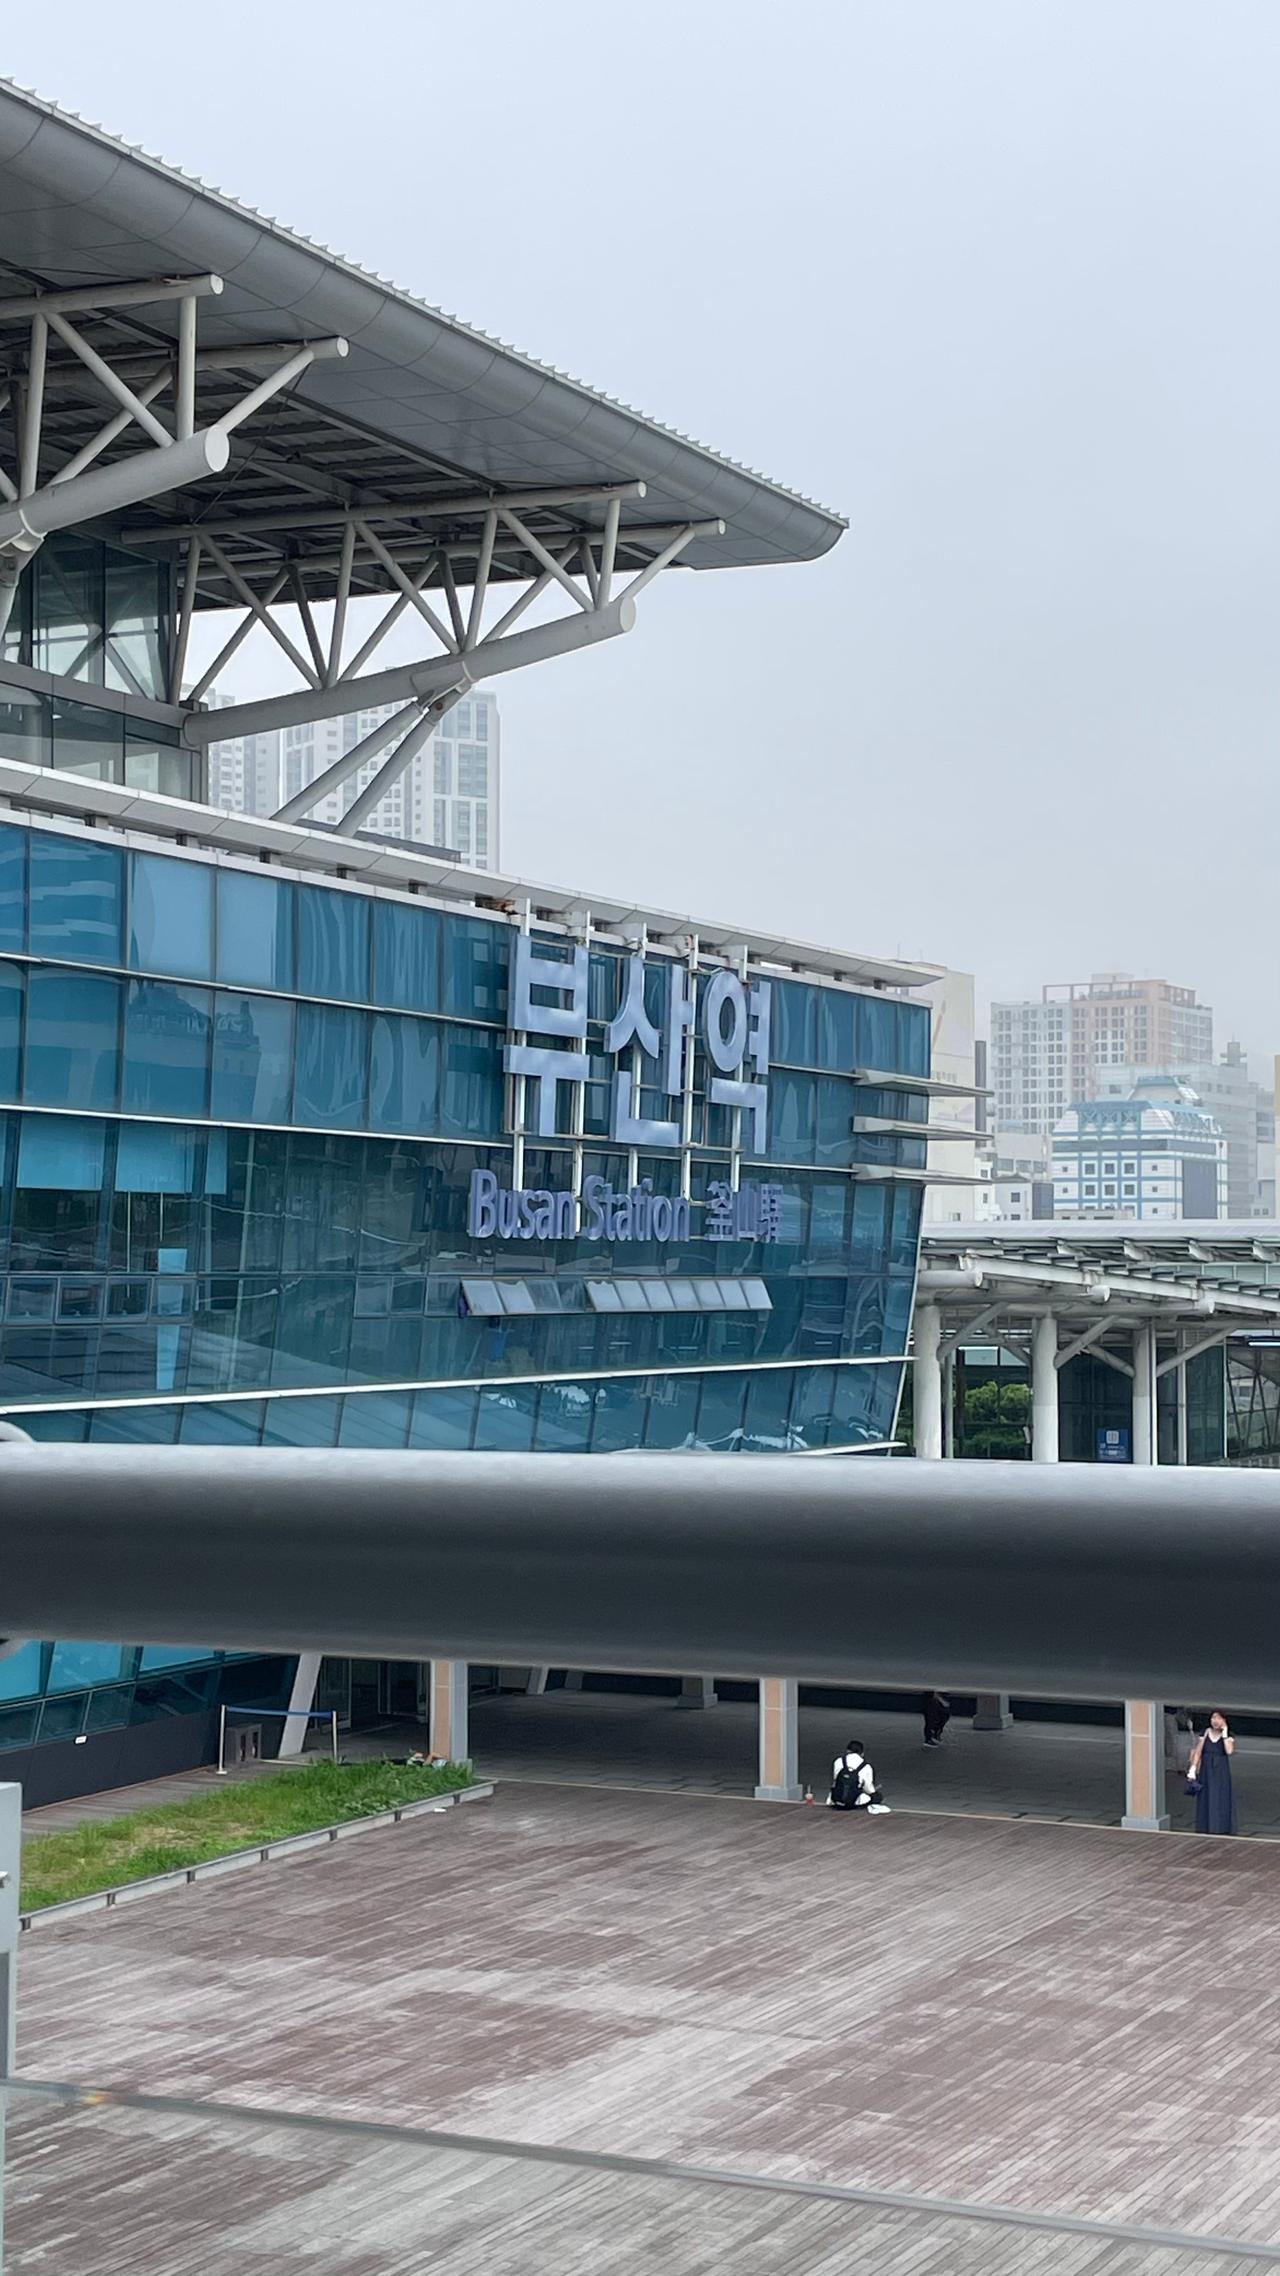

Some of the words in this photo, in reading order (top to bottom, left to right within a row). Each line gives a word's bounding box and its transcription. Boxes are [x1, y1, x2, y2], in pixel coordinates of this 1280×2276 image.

[503, 934, 771, 1154] 부산역
[468, 1168, 576, 1240] Busan
[581, 1174, 690, 1242] Station
